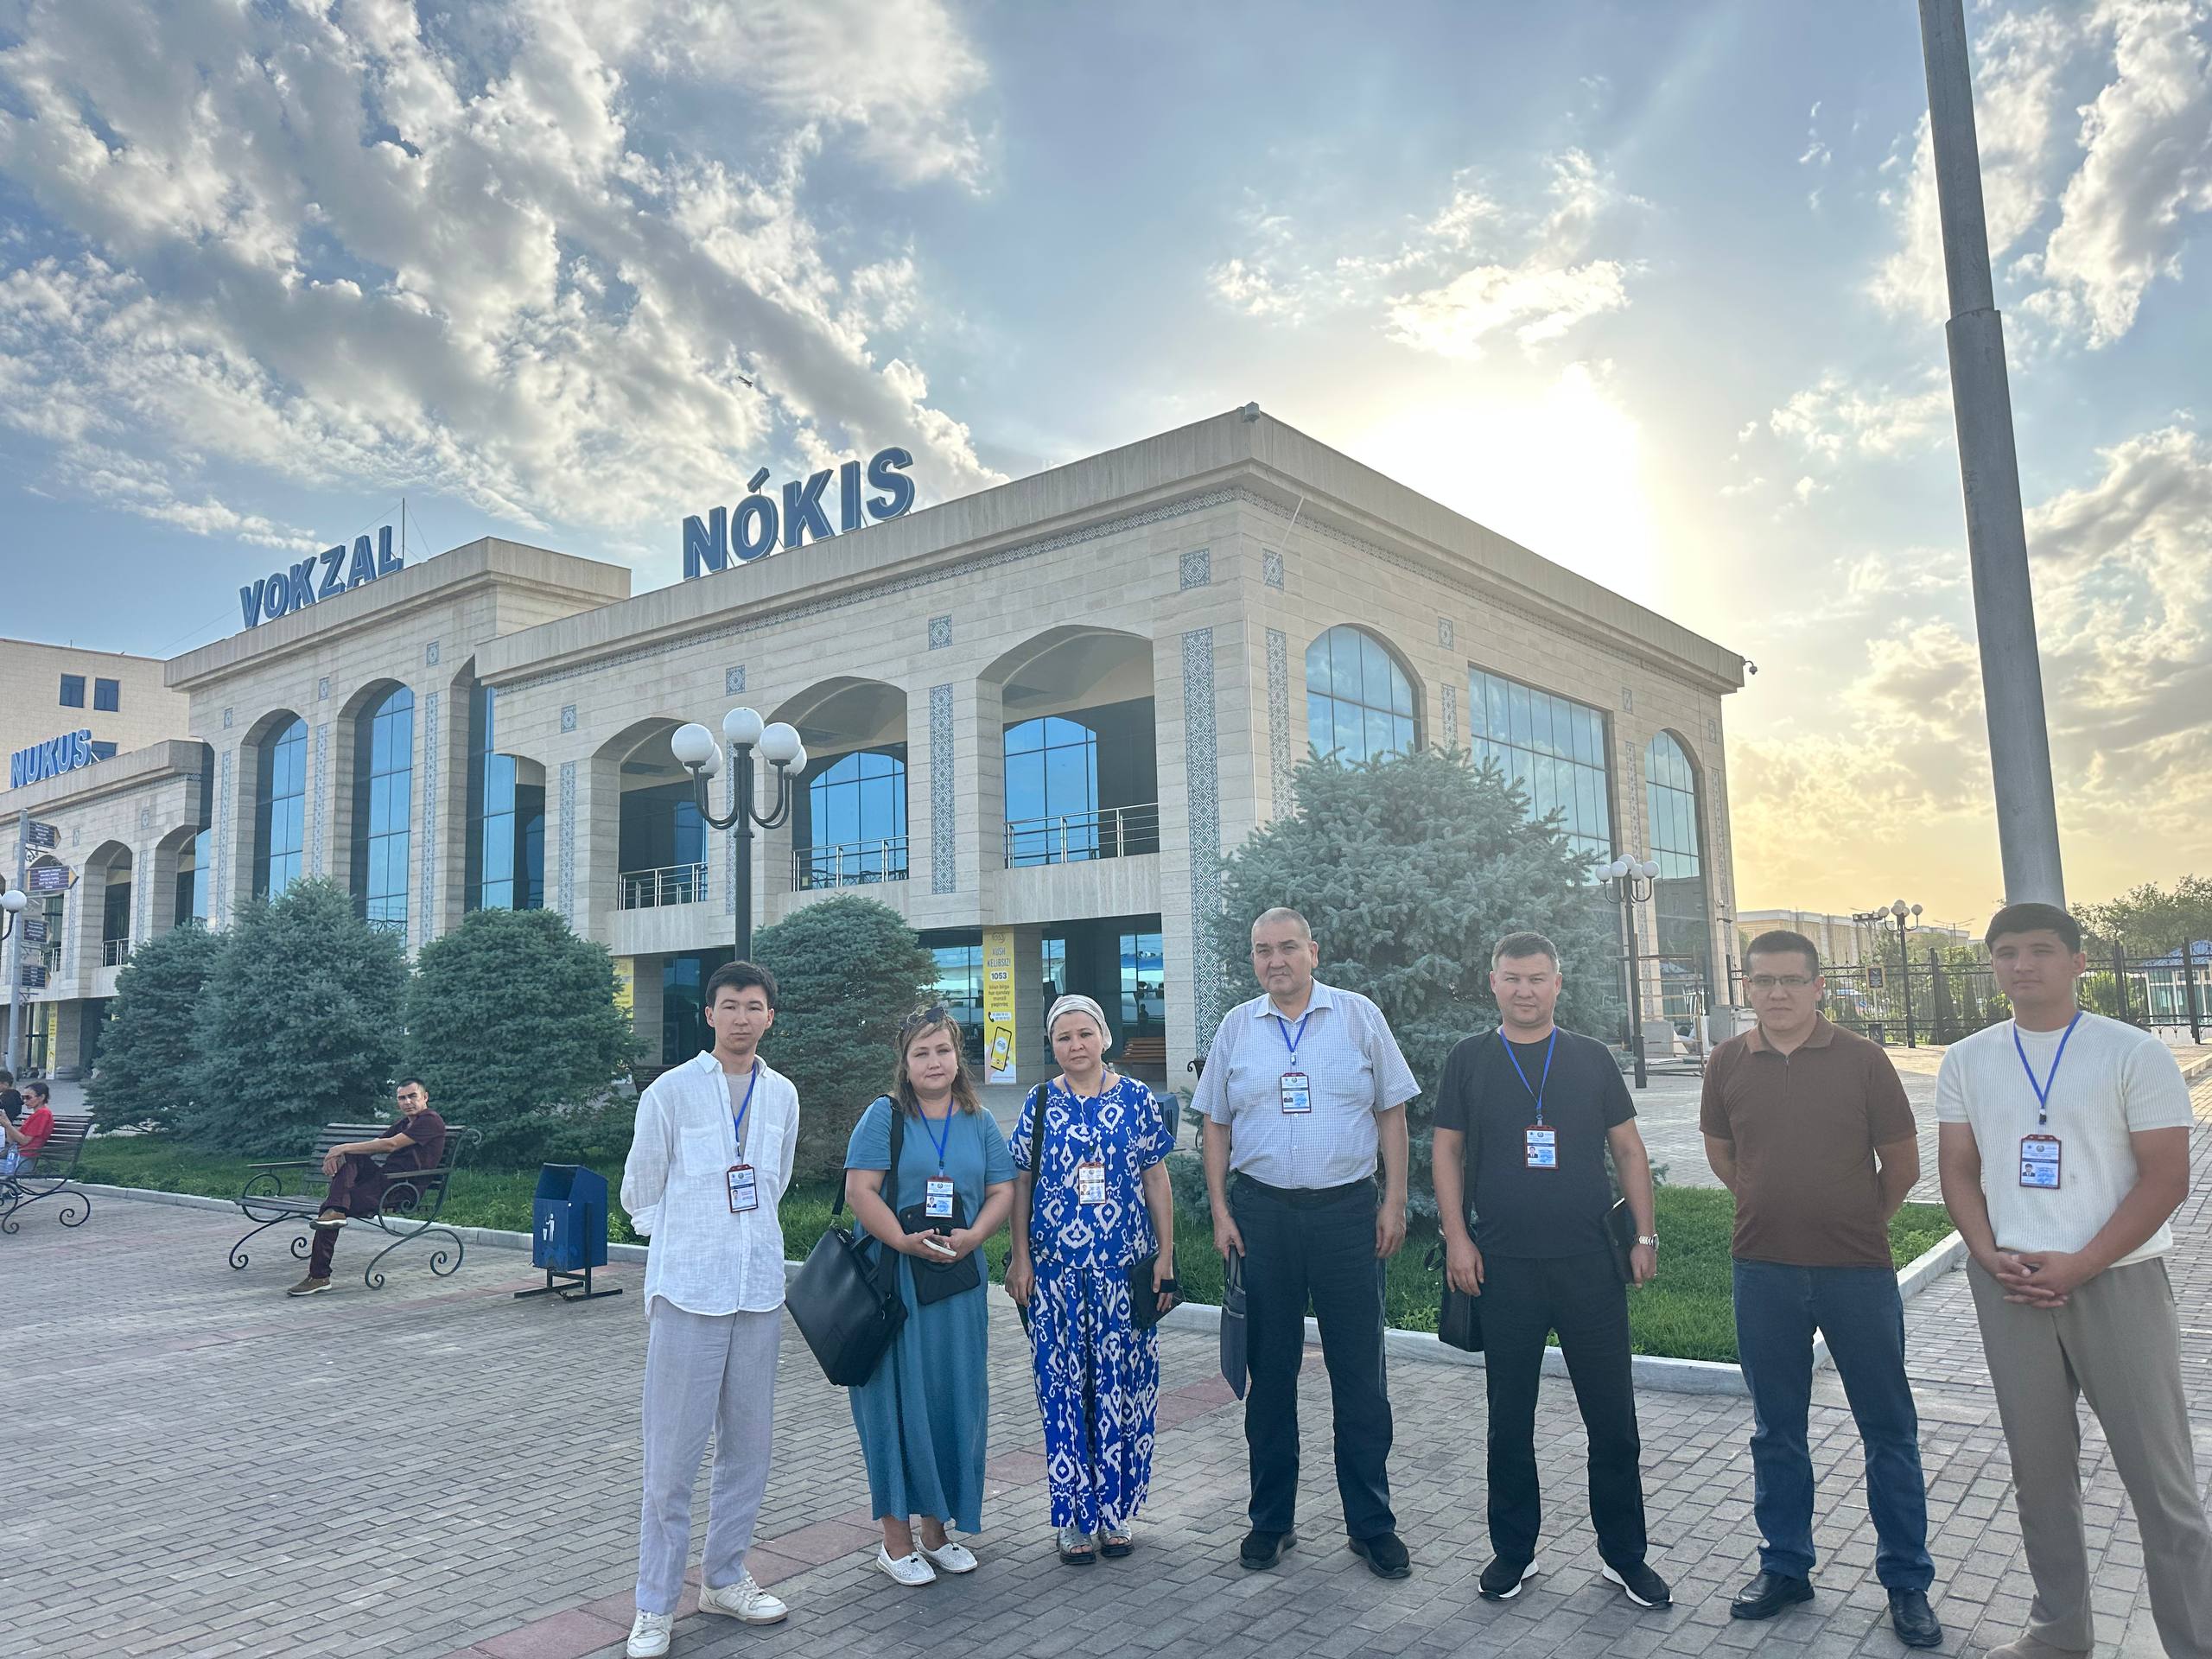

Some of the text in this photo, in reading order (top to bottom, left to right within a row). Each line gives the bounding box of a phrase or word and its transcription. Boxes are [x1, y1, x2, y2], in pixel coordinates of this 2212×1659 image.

[683, 447, 915, 581] NÓKIS
[239, 525, 404, 629] VOKZAL
[10, 728, 92, 788] NUKUS
